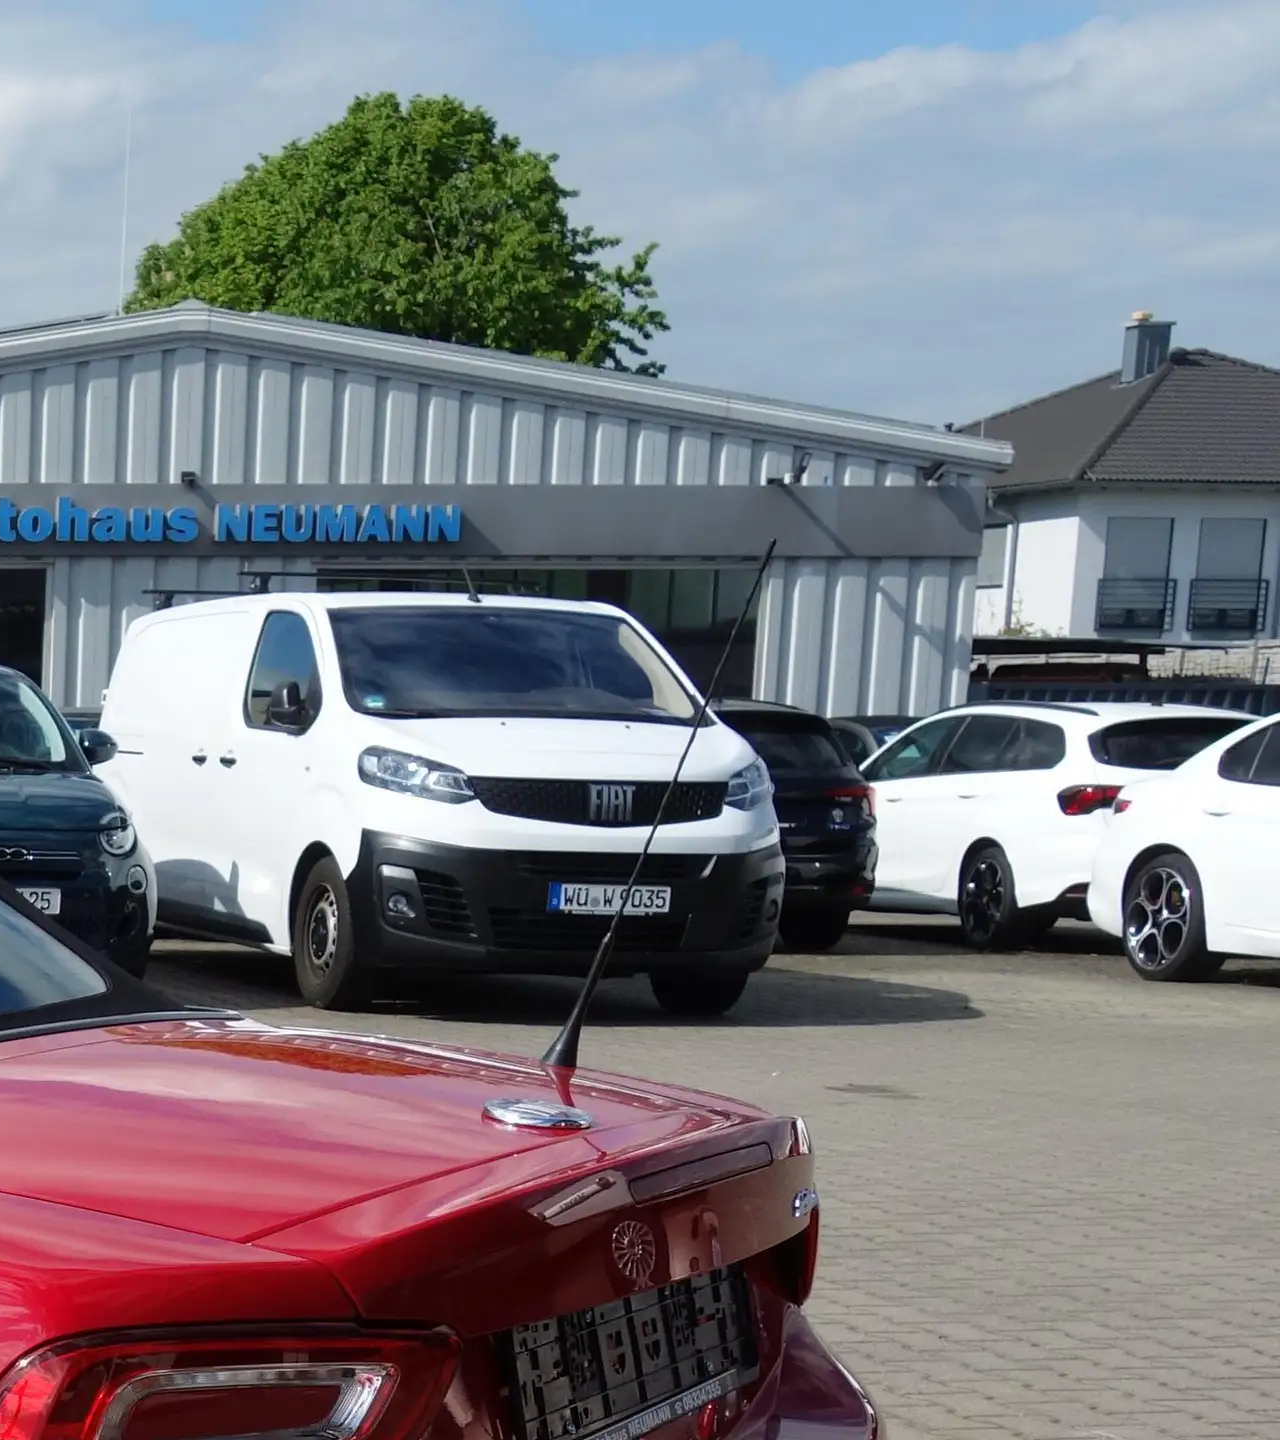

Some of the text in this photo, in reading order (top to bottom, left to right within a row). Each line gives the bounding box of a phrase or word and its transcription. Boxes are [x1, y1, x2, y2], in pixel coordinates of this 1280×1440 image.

[214, 502, 462, 543] NEUMANN
[589, 783, 636, 822] FIAT
[21, 891, 52, 911] 25
[564, 887, 590, 907] WÜ
[628, 1404, 672, 1438] NEUMANN
